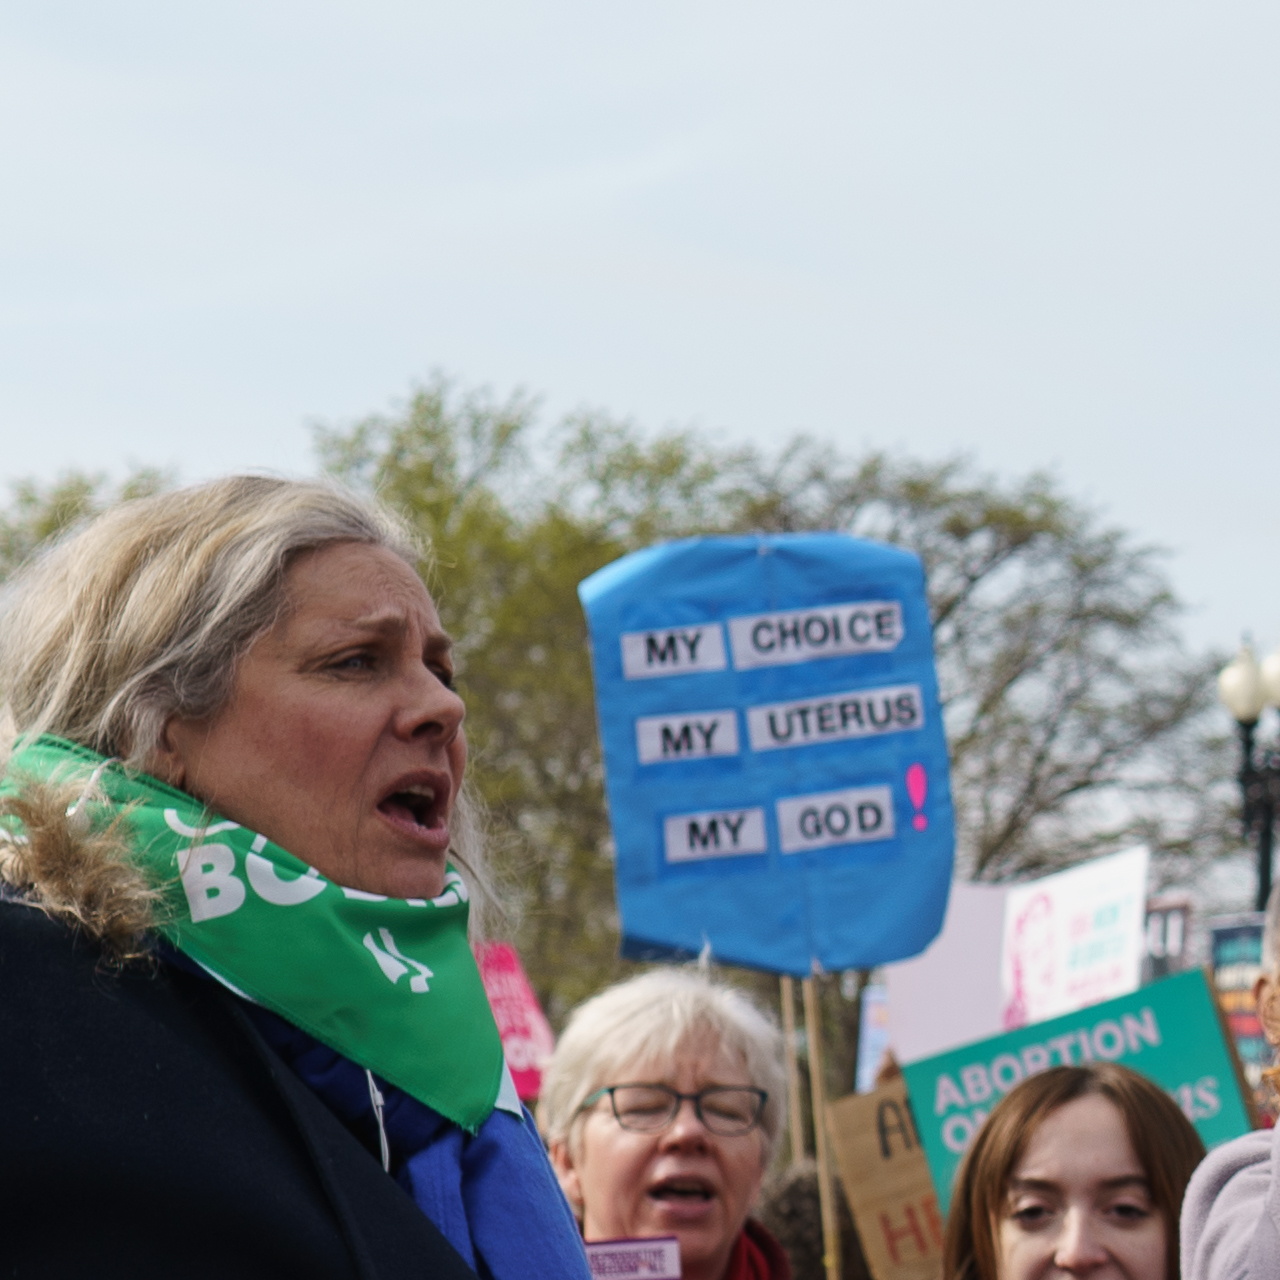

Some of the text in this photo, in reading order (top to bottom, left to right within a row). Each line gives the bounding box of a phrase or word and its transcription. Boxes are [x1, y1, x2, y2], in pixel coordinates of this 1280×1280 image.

[645, 609, 895, 666] MY CHOICE
[660, 693, 917, 756] MY UTERUS
[688, 813, 746, 848] MY
[799, 801, 883, 838] GOD
[934, 1007, 1162, 1116] ABORTION
